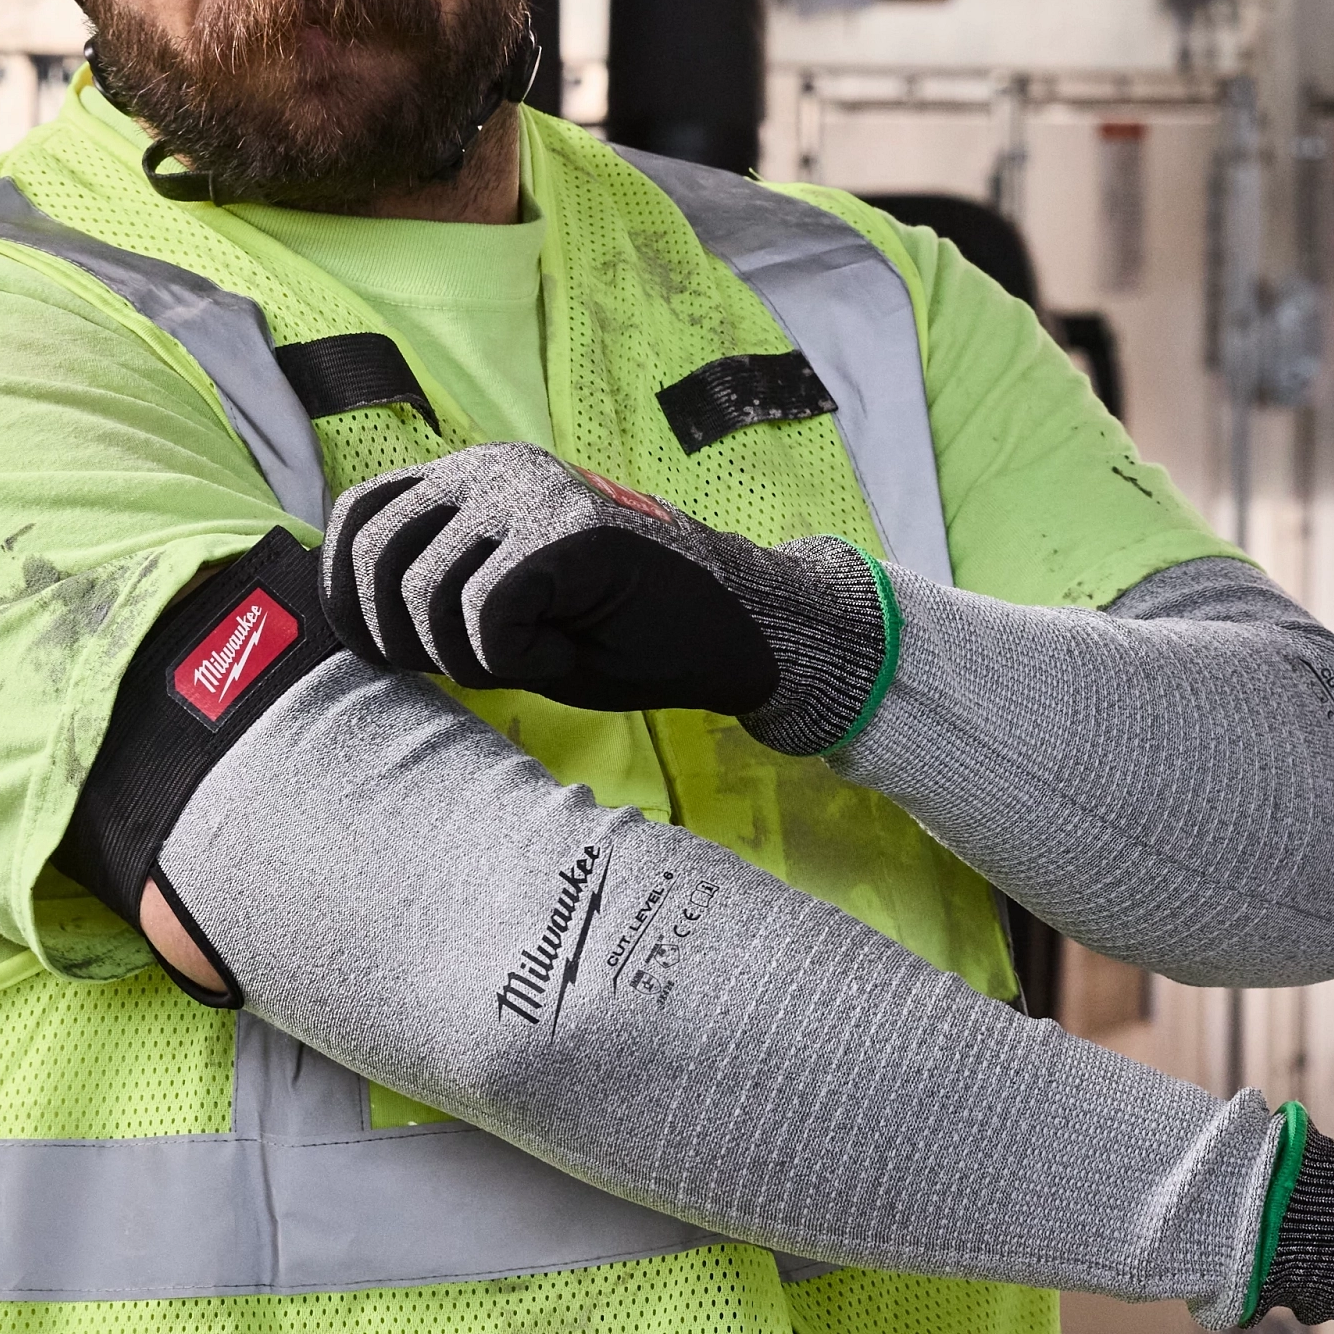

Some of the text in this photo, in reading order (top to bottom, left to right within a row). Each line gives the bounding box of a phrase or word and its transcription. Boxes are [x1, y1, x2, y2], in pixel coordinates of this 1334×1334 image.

[194, 605, 262, 693] Milwaukee
[496, 845, 601, 1025] Milwaukee
[607, 871, 674, 967] CUT LEVEL 6
